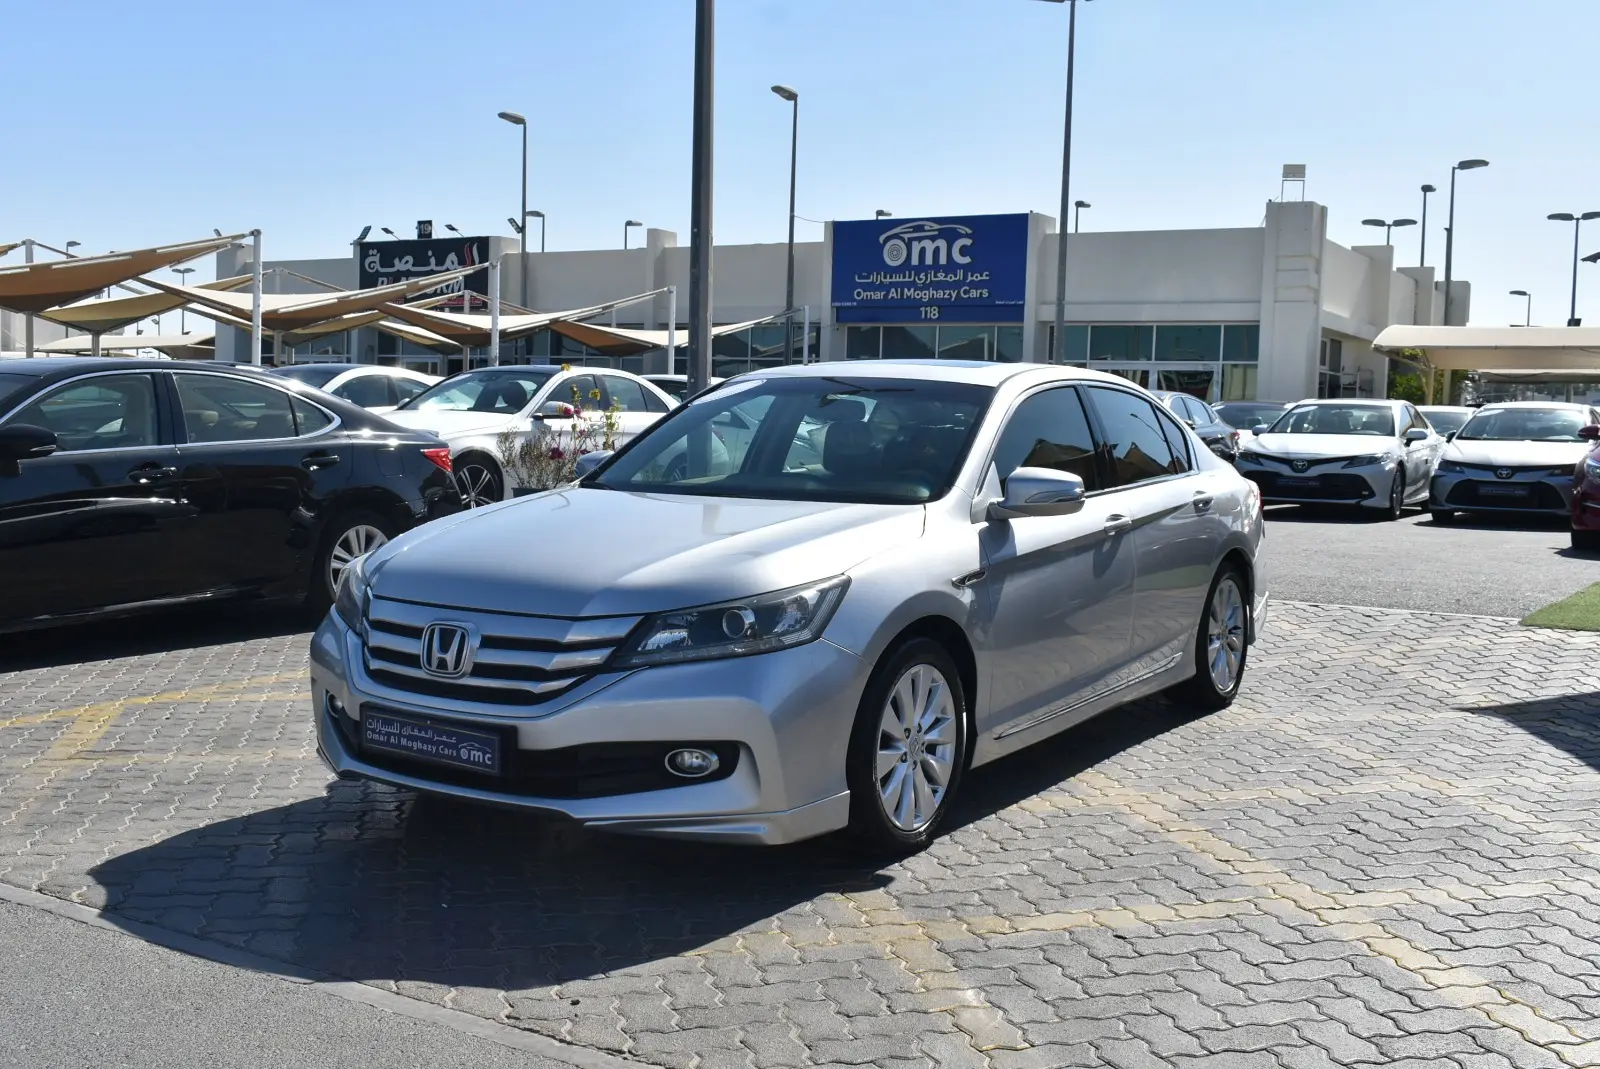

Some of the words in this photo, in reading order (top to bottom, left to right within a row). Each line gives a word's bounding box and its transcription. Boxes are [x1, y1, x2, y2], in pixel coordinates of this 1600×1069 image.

[855, 270, 915, 285] للسيارات
[915, 269, 963, 287] المغازي
[966, 271, 990, 283] عمر
[854, 288, 886, 300] Omar
[888, 287, 901, 299] Al
[903, 287, 957, 301] Moghazy
[960, 286, 989, 298] Cars
[920, 306, 939, 319] 118
[366, 719, 400, 734] للسيارات
[366, 730, 387, 742] Omar
[390, 735, 398, 744] Al
[400, 737, 437, 753] Moghazy
[438, 745, 457, 757] Cars
[433, 734, 457, 743] عمر
